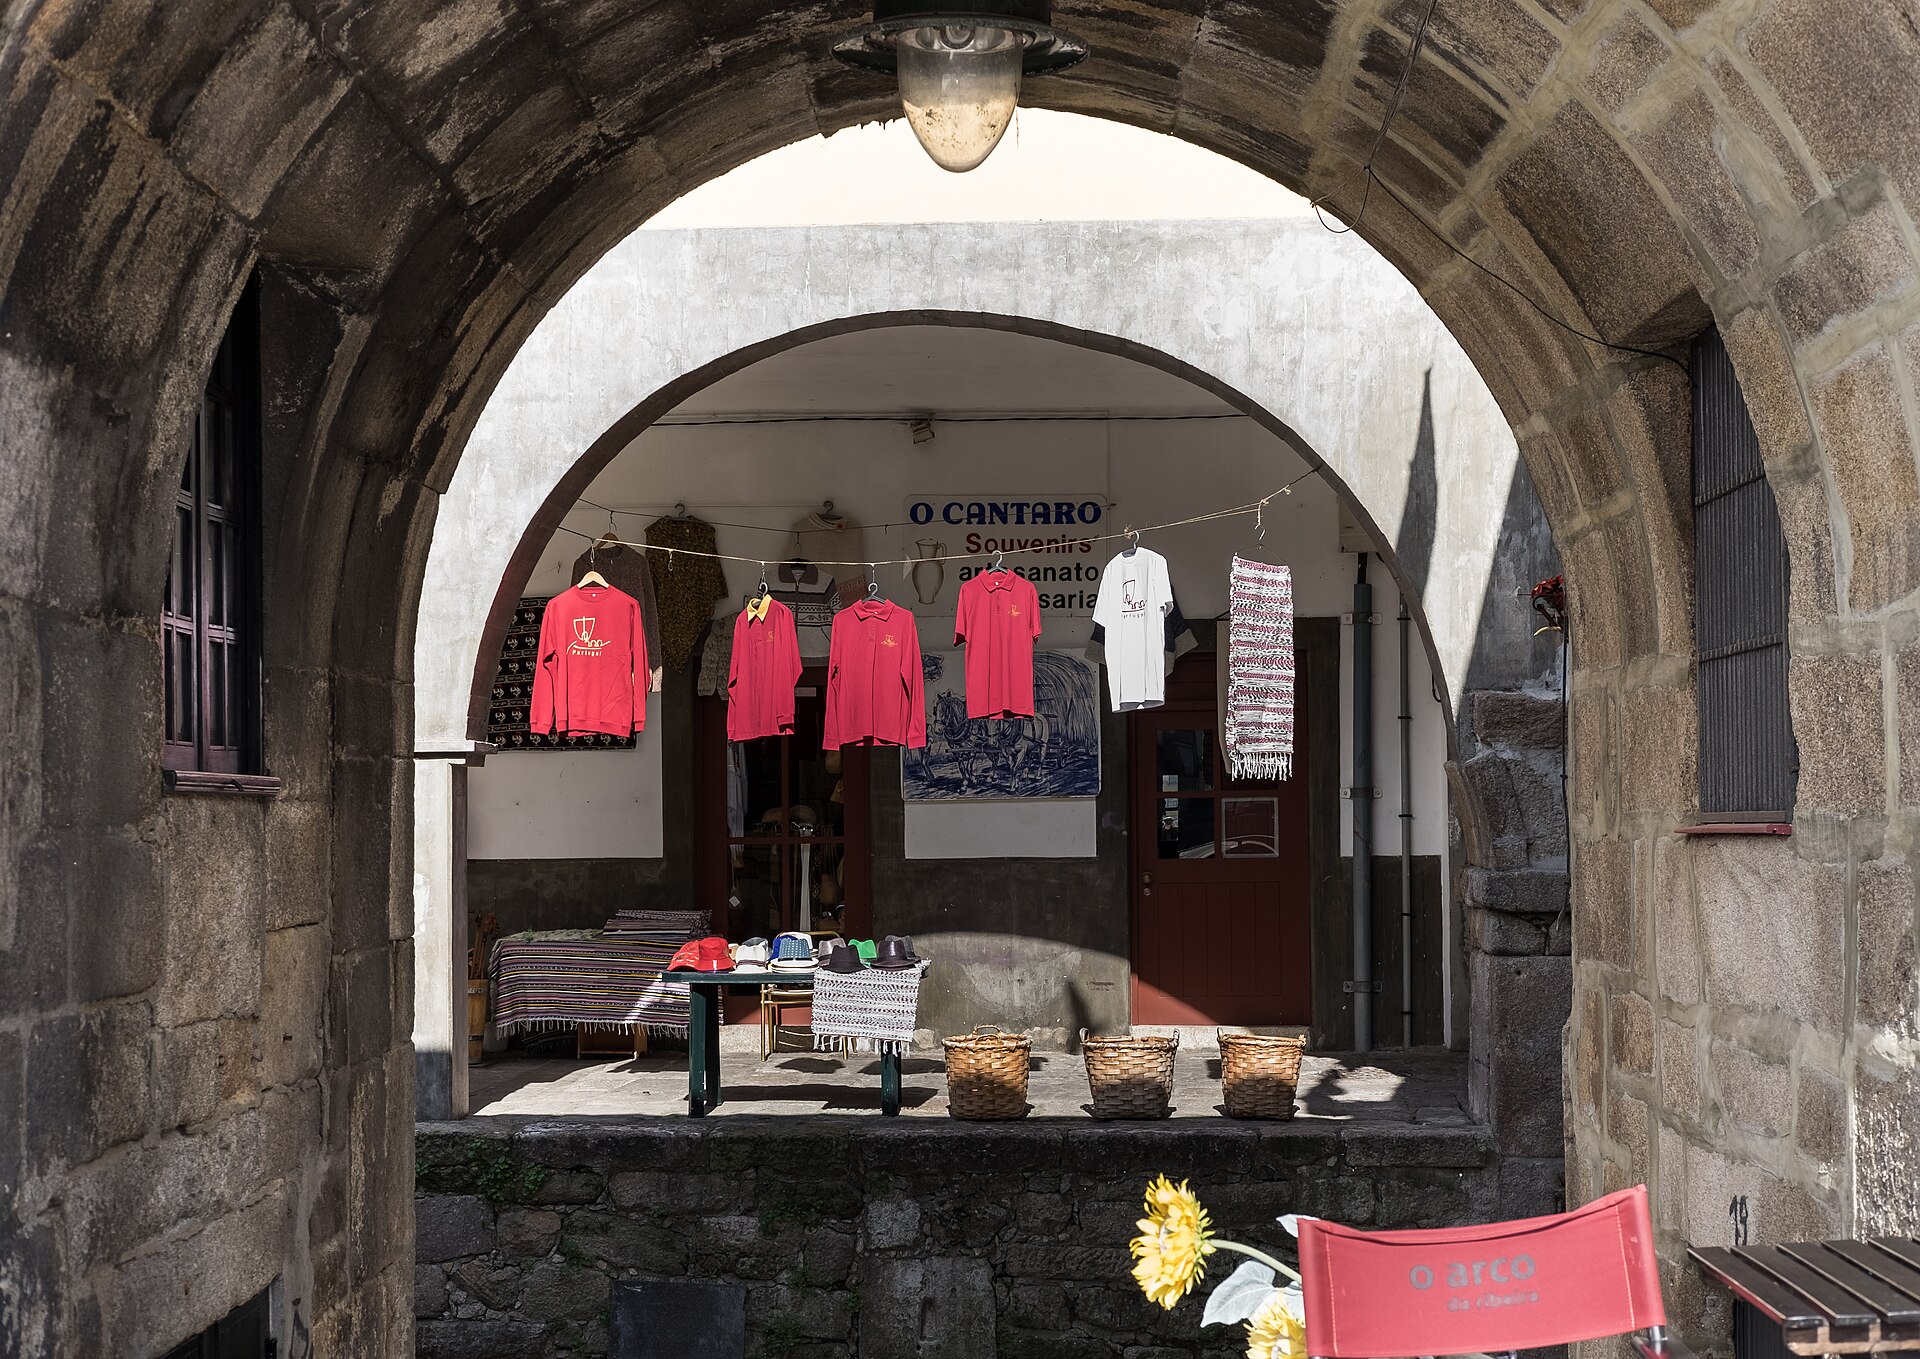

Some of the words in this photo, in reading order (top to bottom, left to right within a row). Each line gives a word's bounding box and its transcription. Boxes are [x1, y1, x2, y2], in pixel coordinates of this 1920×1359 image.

[909, 502, 934, 525] O
[942, 501, 1103, 525] CANTARO
[965, 532, 1093, 554] Souvenirs
[1446, 1253, 1536, 1288] arco
[1447, 1295, 1471, 1312] da
